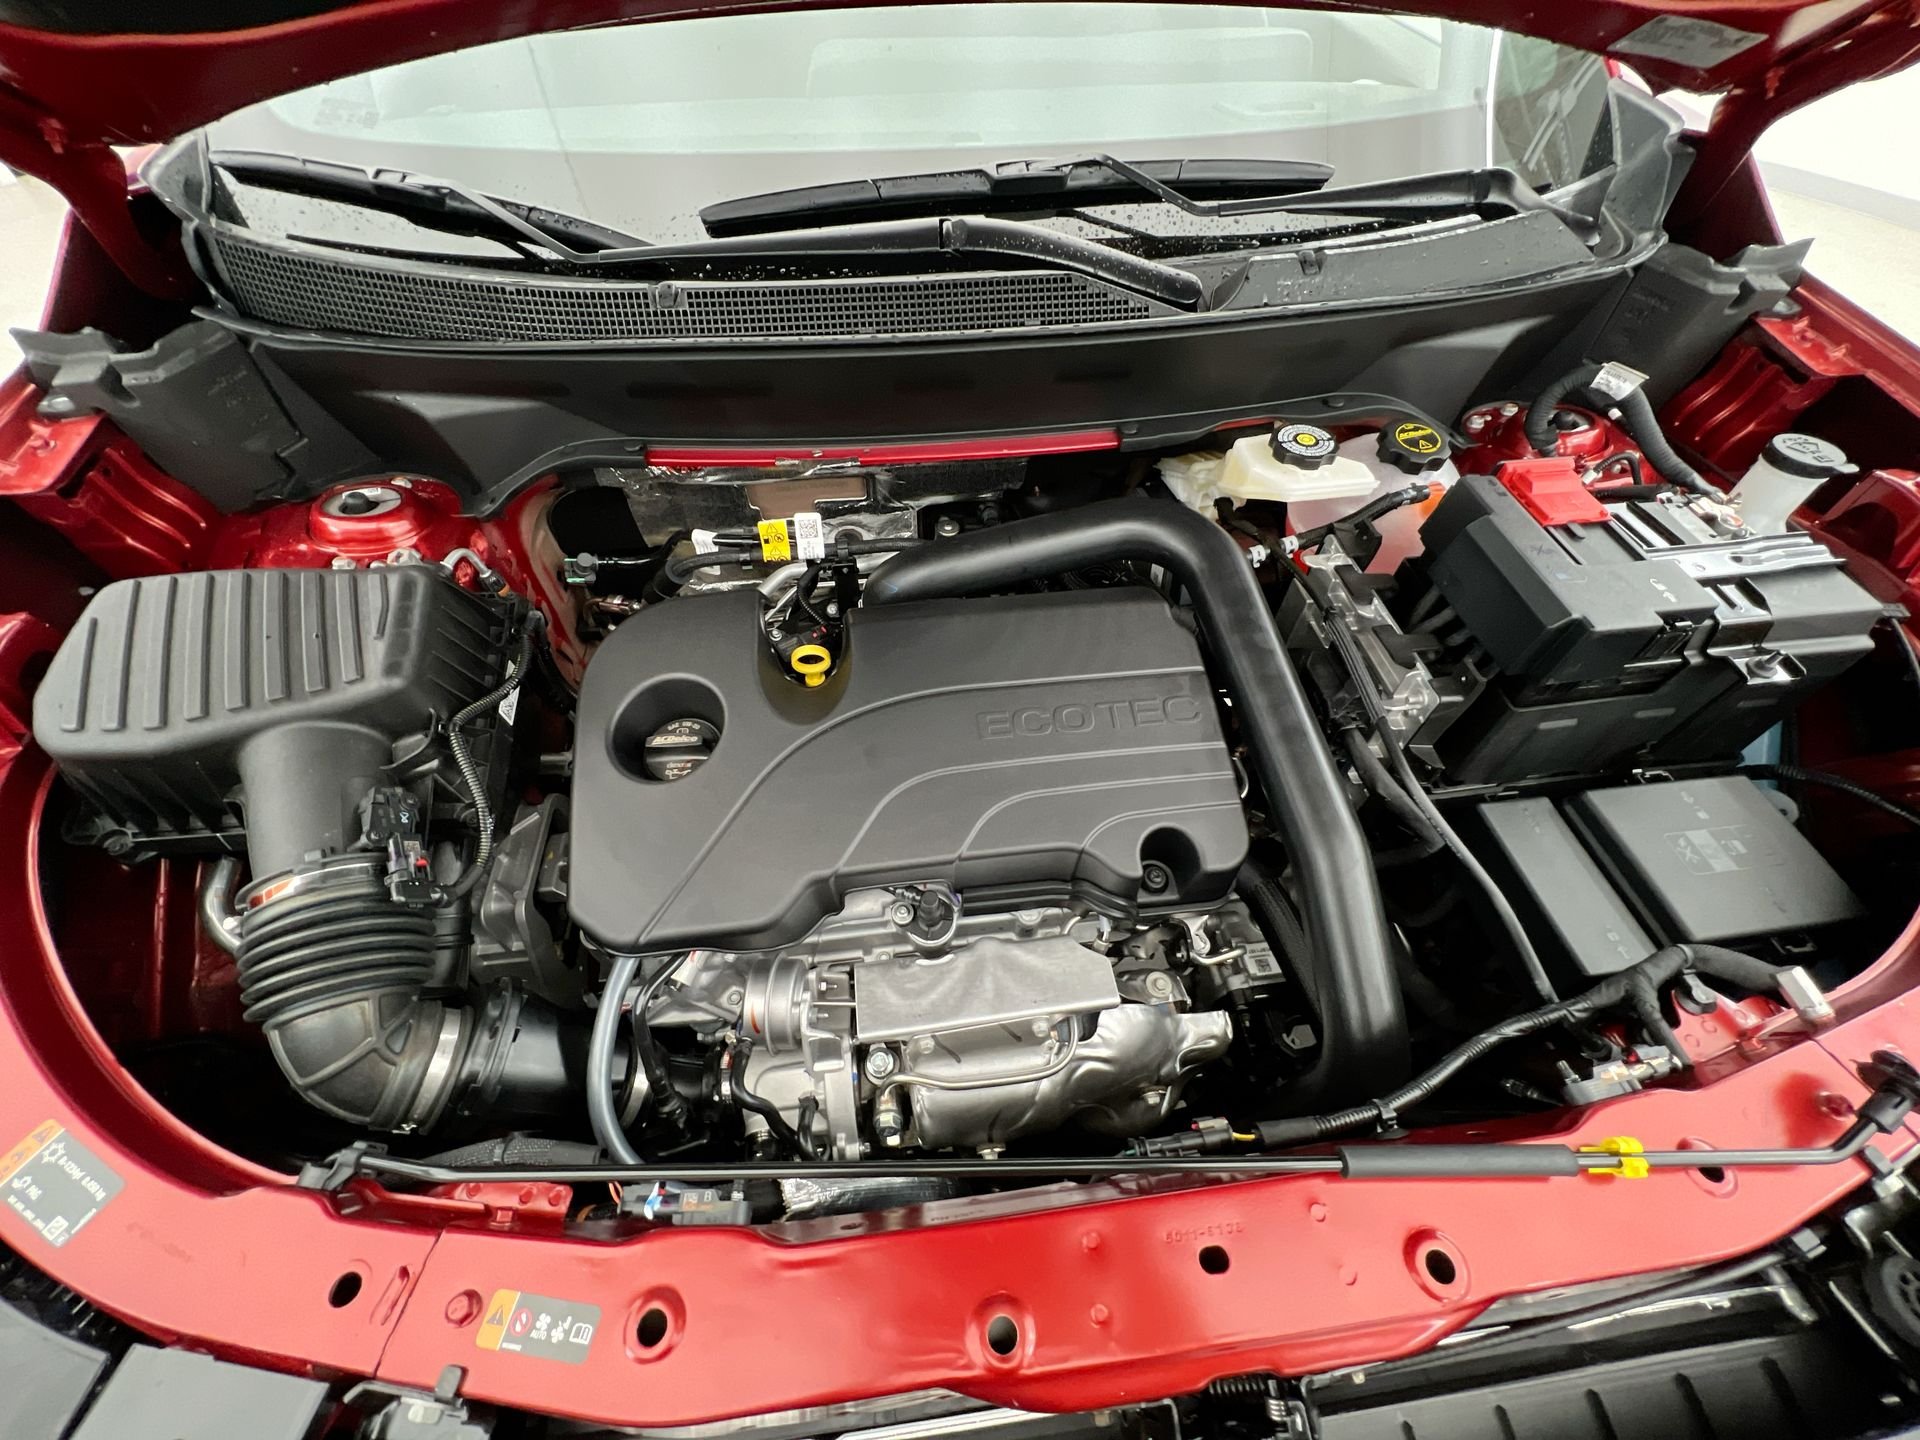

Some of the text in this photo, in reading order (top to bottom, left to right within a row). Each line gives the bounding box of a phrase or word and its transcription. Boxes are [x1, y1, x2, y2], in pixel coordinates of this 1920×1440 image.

[976, 696, 1201, 740] ECOTEC
[652, 735, 698, 745] ACDelco
[530, 1329, 547, 1340] AUTO
